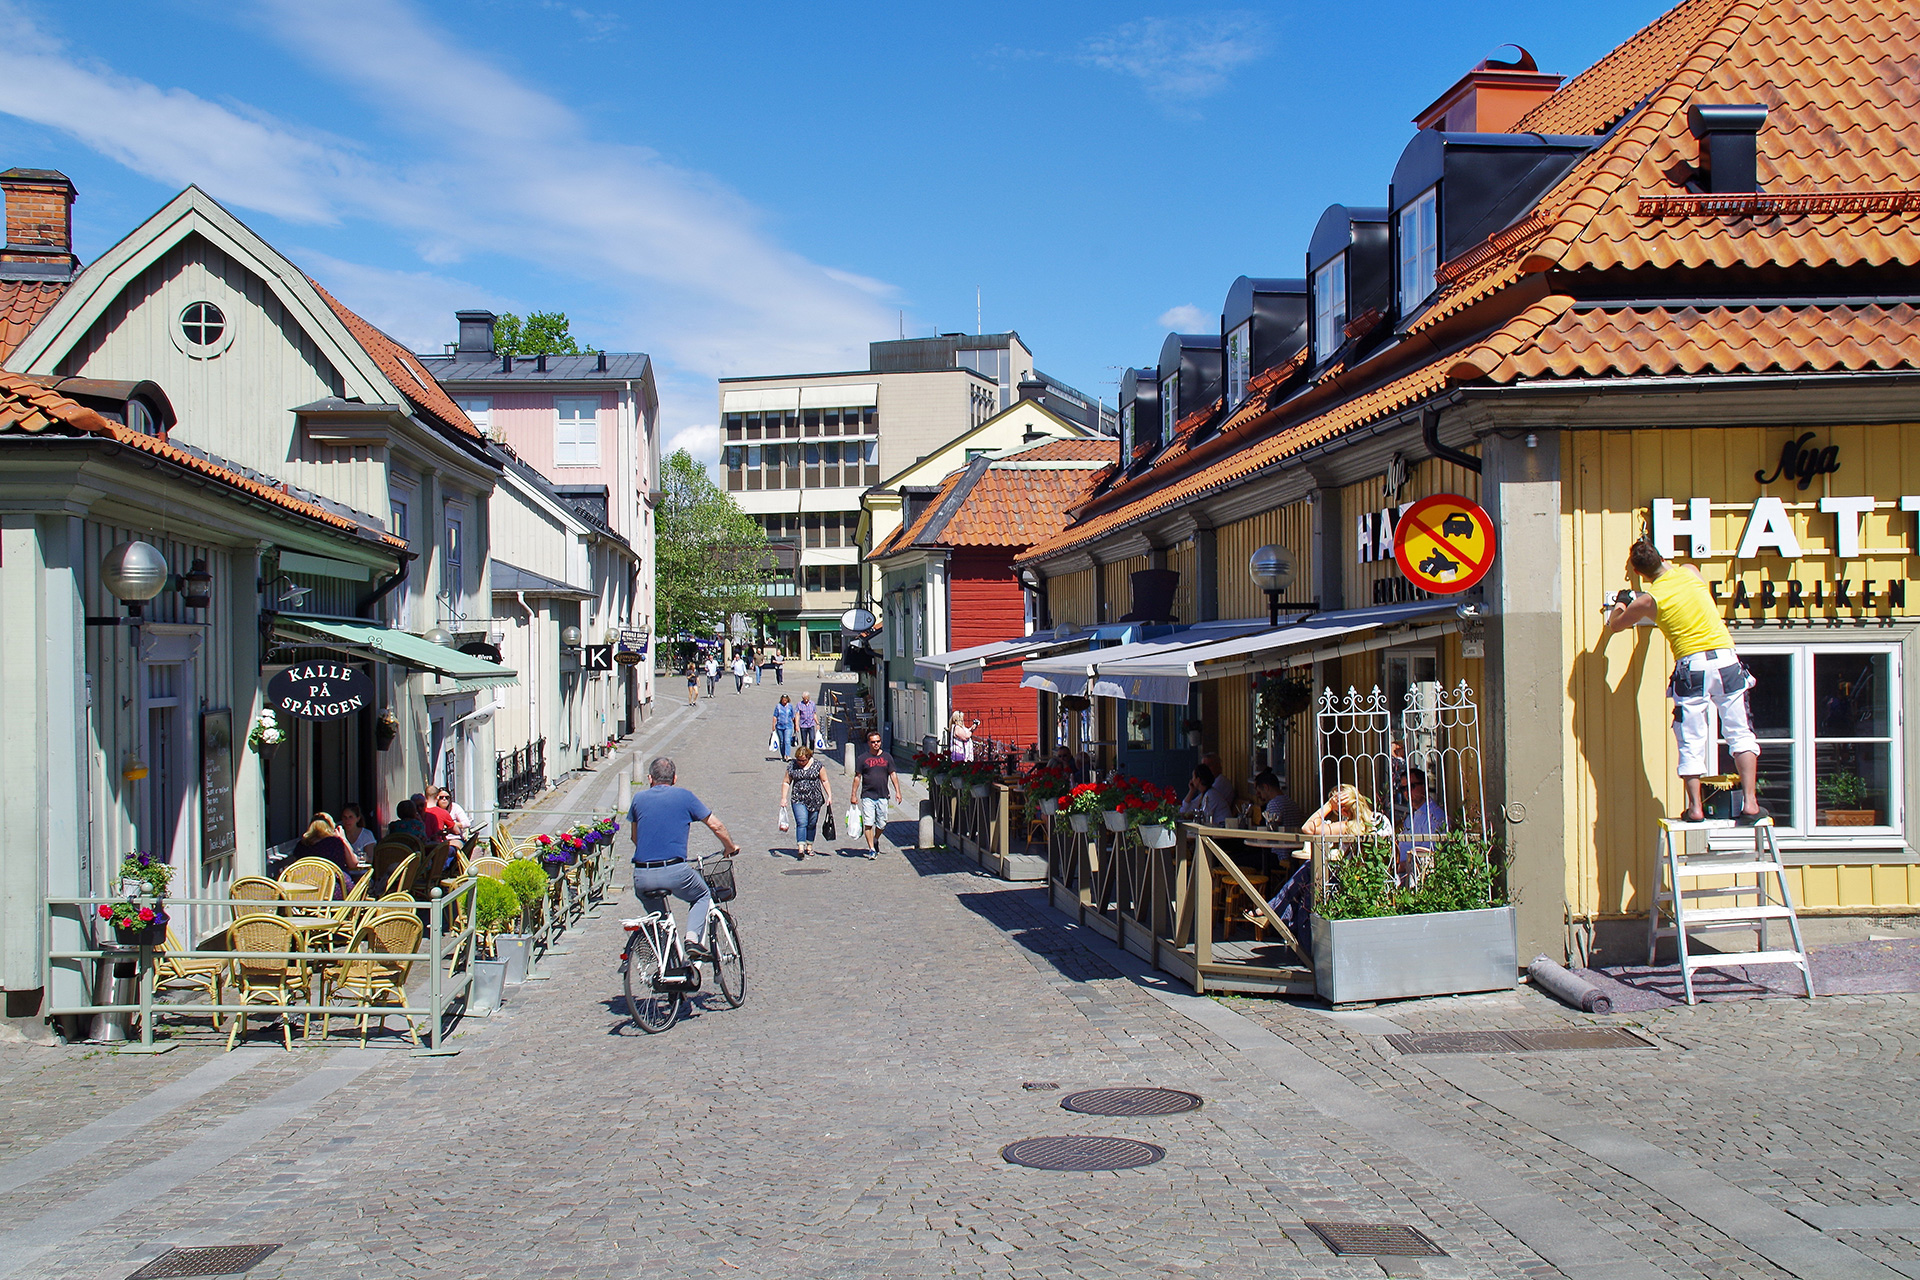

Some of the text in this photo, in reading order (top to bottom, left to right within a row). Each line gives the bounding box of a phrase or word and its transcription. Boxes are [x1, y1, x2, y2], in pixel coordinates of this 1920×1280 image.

[1755, 431, 1841, 491] Nya
[1382, 451, 1410, 500] Nya
[1357, 501, 1416, 565] HA
[1708, 579, 1906, 610] FABRIKEN
[591, 648, 608, 668] K
[288, 665, 352, 682] KALLE
[309, 682, 331, 697] PÅ
[281, 695, 363, 717] SPÅNGEN
